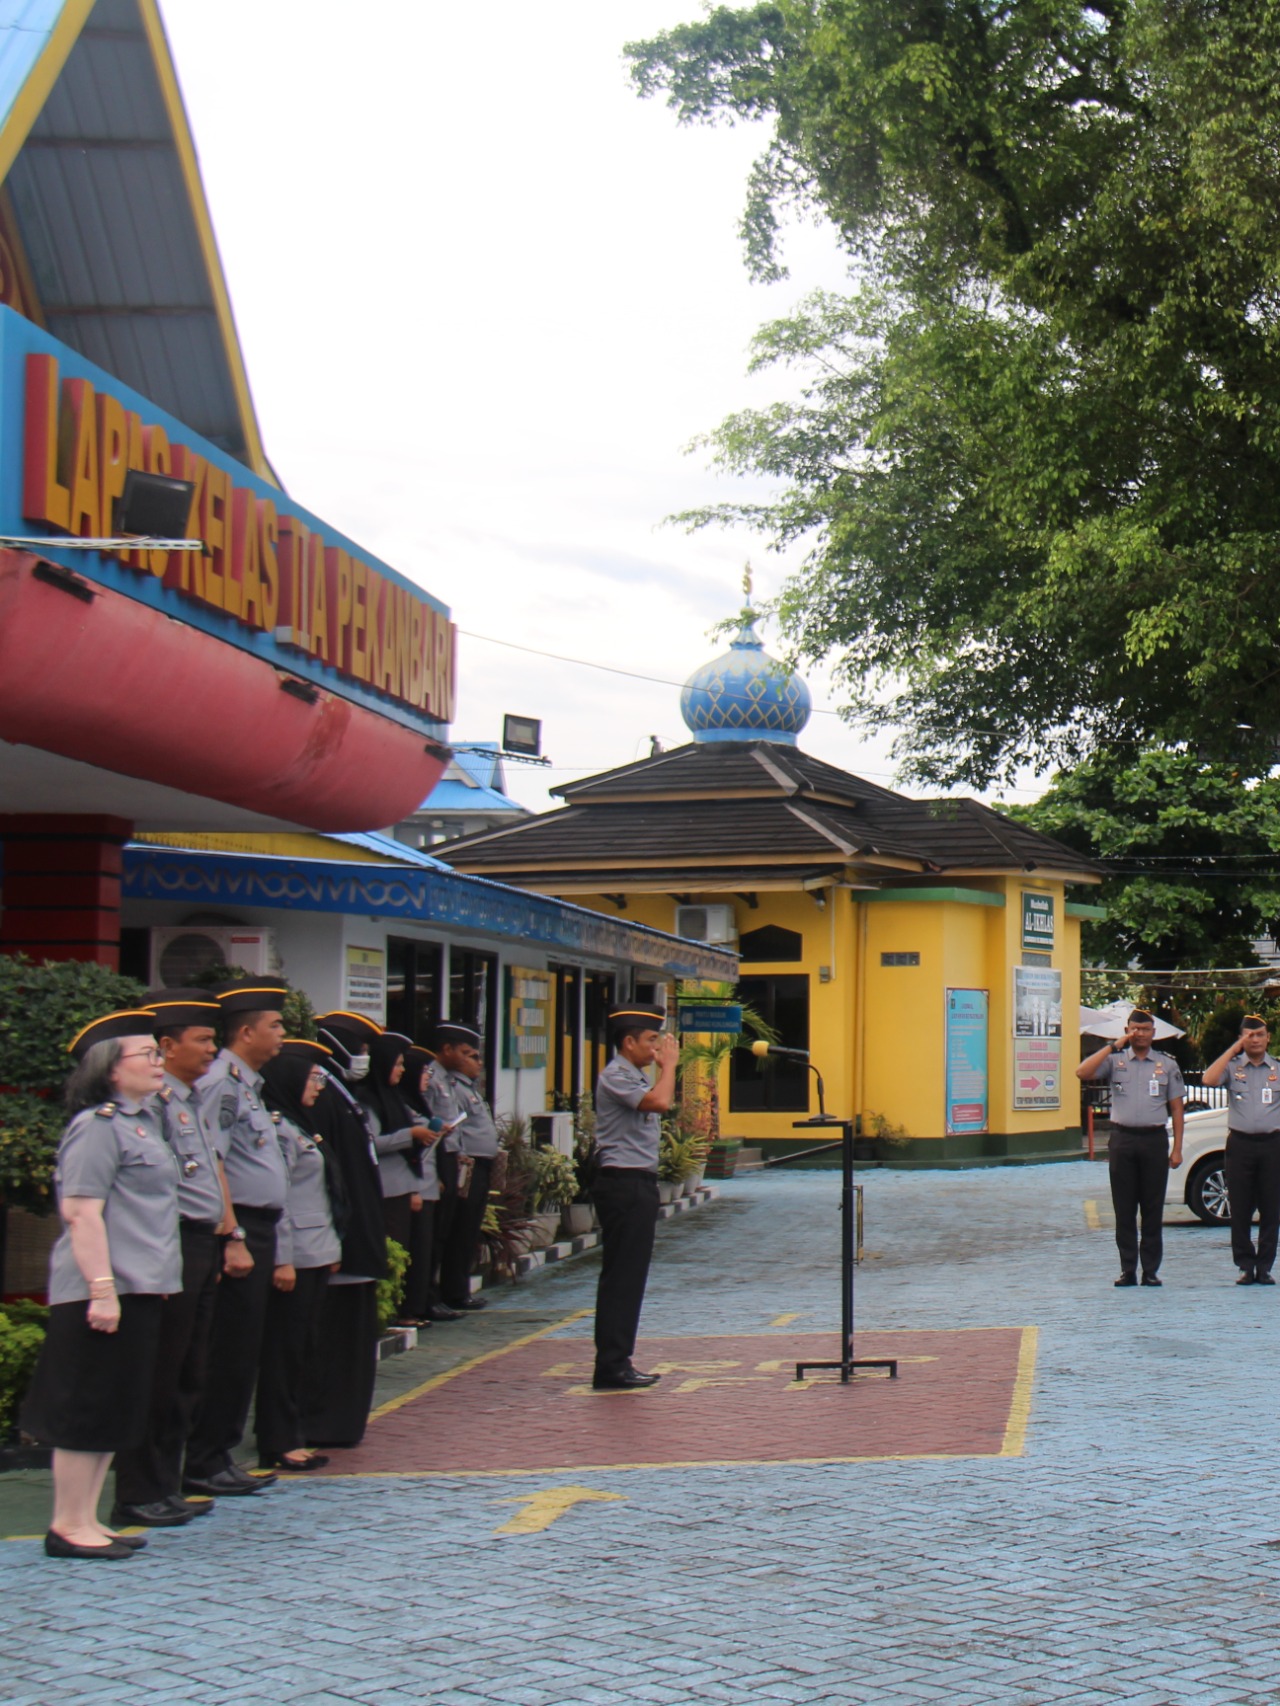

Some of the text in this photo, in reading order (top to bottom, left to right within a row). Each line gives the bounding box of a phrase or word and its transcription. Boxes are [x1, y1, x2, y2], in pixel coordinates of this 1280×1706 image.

[164, 444, 279, 633] KELAS
[326, 546, 457, 724] PEKANBARU
[1025, 912, 1053, 933] AL-IKHLAS
